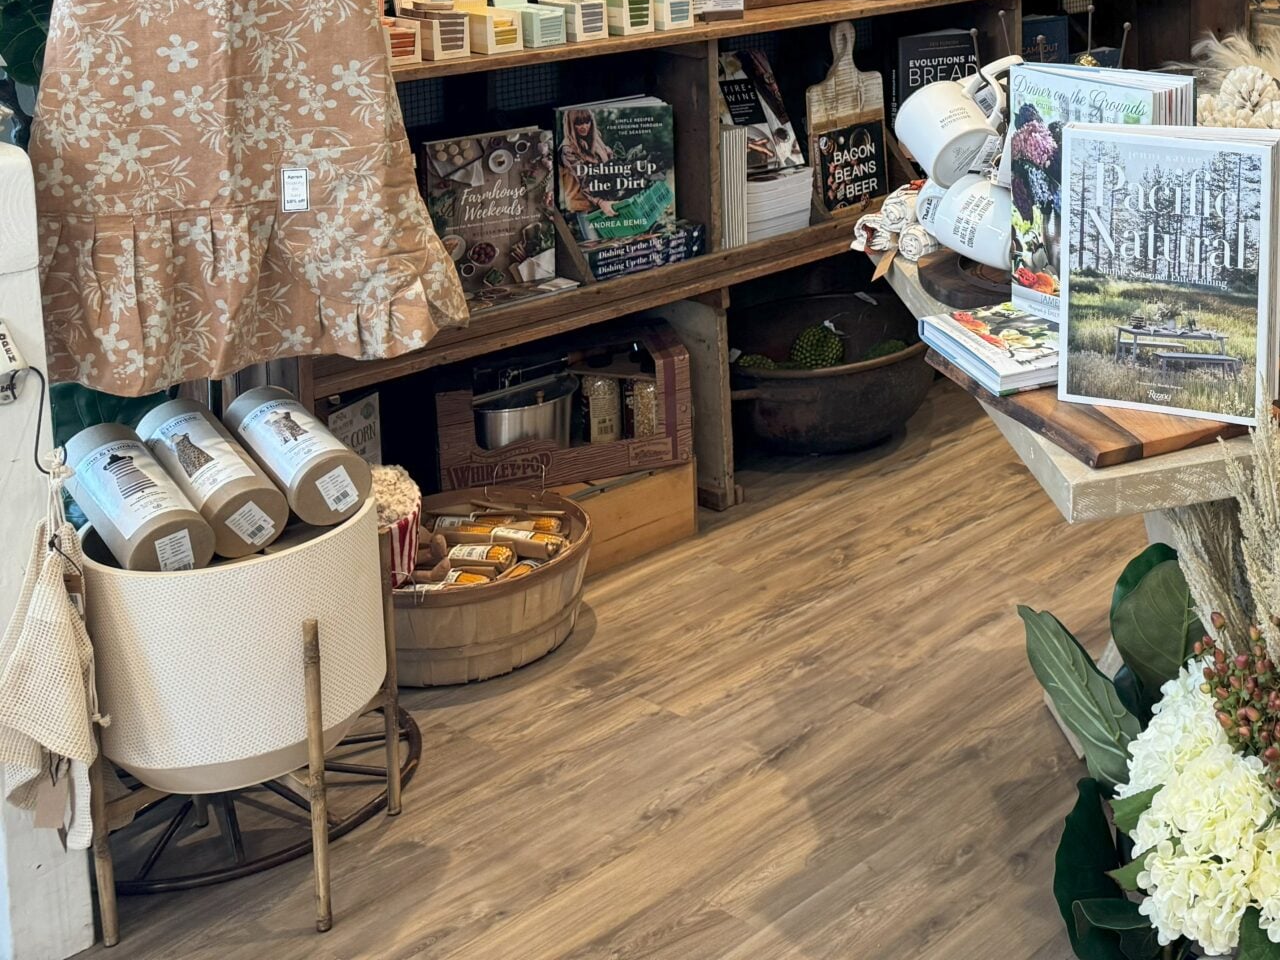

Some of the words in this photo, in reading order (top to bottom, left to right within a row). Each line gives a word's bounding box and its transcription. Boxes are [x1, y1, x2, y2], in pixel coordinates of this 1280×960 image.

[908, 56, 963, 68] EVOLUTIONS
[964, 54, 977, 63] IN
[908, 63, 979, 87] BREAD
[724, 84, 746, 94] FIRE
[726, 92, 756, 102] WINE
[1013, 74, 1051, 98] Dinner
[1053, 91, 1067, 104] on
[1070, 87, 1087, 106] the
[1089, 90, 1148, 120] Grounds
[833, 142, 876, 165] BACON
[575, 162, 632, 179] Dishing
[636, 159, 657, 177] Up
[834, 160, 877, 183] BEANS
[460, 180, 527, 206] Farmhouse
[588, 178, 612, 193] the
[616, 176, 646, 191] Dirt
[845, 177, 879, 199] BEER
[1096, 162, 1240, 221] Pacific
[464, 199, 525, 222] Weekends
[588, 220, 621, 230] ANDREA
[623, 218, 648, 227] BEMIS
[1084, 208, 1248, 271] Natural
[598, 248, 625, 260] Dishing
[598, 263, 625, 275] Dishing
[1098, 265, 1129, 278] Simple
[1130, 269, 1168, 282] Seasonal
[1170, 273, 1228, 292] Entertaining
[1040, 294, 1060, 306] JAME
[350, 421, 377, 449] CORN
